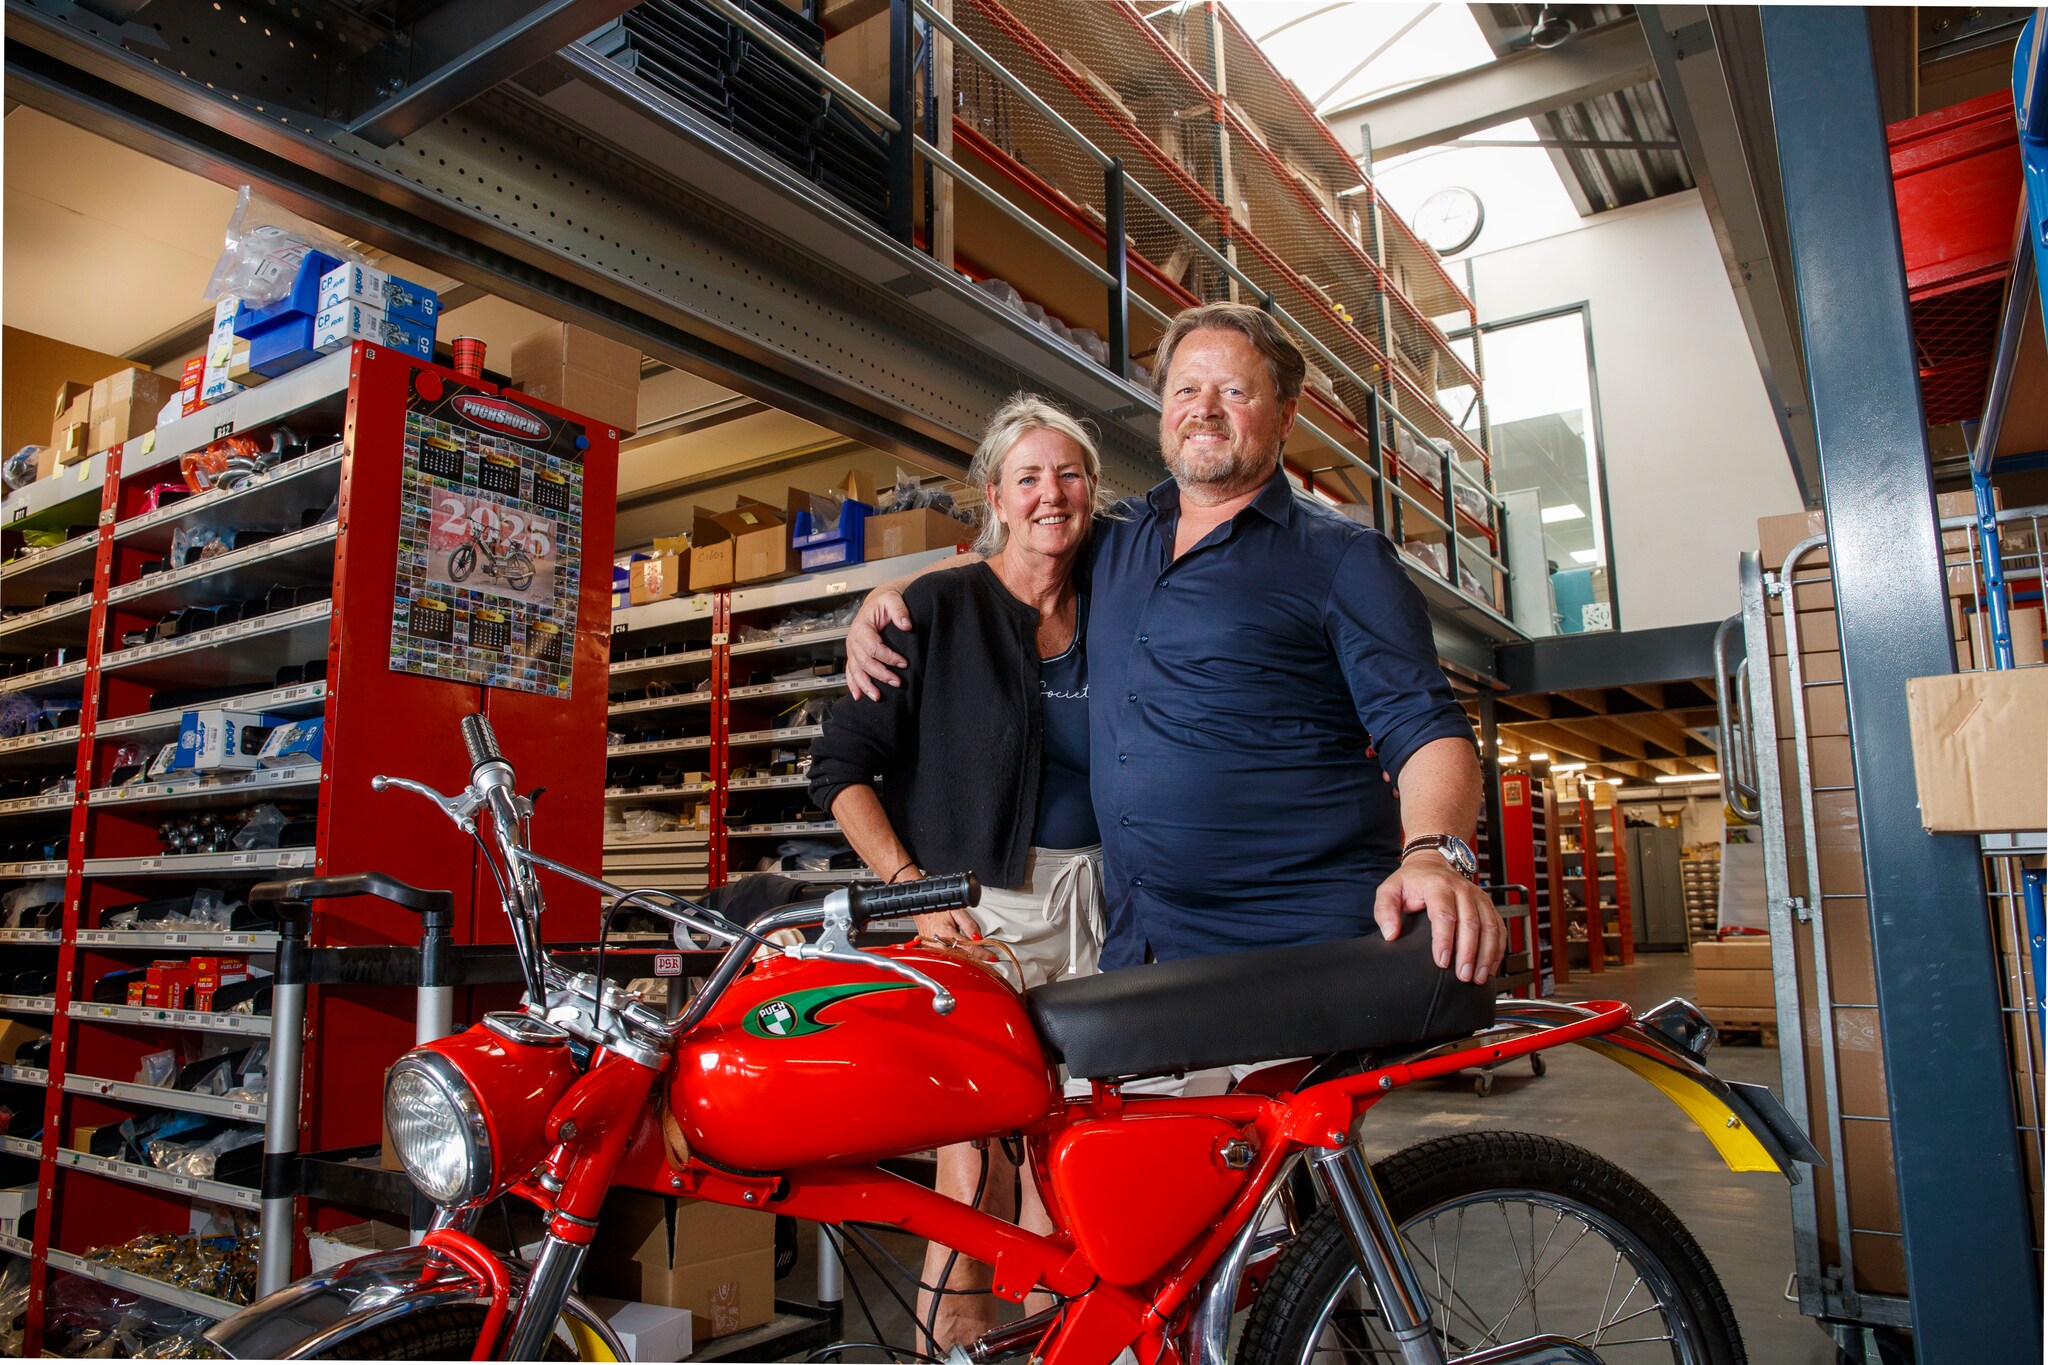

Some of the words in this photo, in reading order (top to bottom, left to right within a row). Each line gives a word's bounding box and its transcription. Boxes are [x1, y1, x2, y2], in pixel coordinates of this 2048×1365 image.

[321, 276, 333, 291] CP
[424, 298, 434, 315] CP
[317, 313, 330, 328] CP
[367, 349, 374, 358] B
[420, 337, 430, 354] CP
[462, 399, 541, 436] PUCHSHOP.DE
[438, 498, 550, 556] 2025
[225, 720, 236, 757] polini
[658, 958, 679, 969] PSR
[758, 1001, 786, 1018] PUCH
